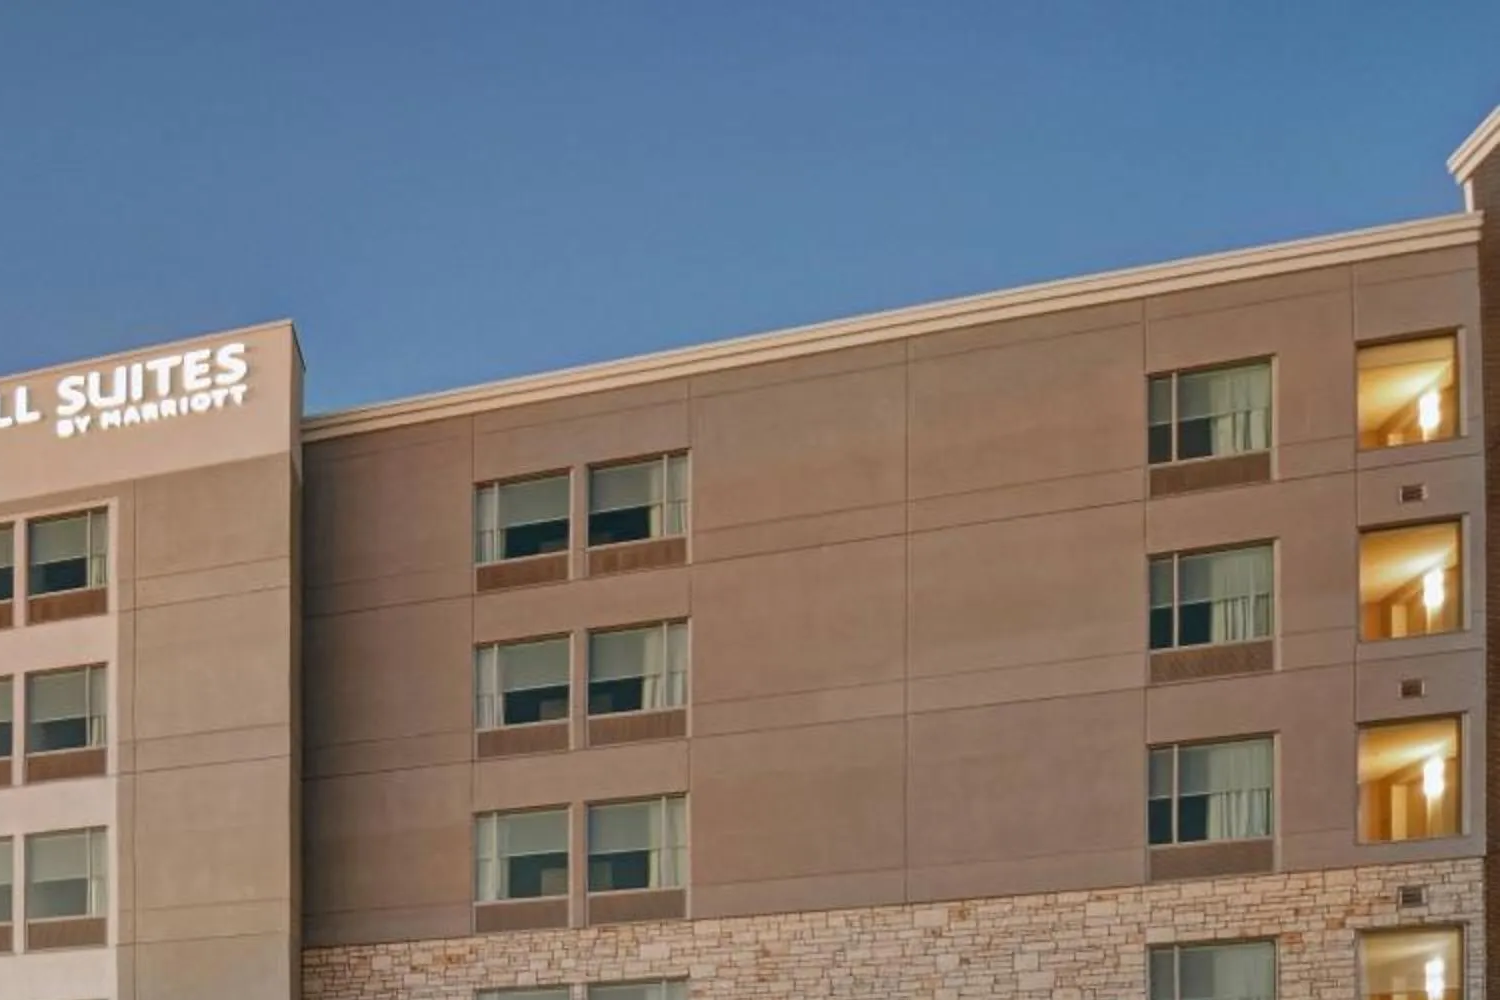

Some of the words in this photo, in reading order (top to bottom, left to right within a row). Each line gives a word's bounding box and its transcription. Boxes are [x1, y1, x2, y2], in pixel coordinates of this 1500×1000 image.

[56, 343, 247, 416] SUITES
[56, 415, 91, 439] BY
[100, 384, 248, 431] MARRIOTT
